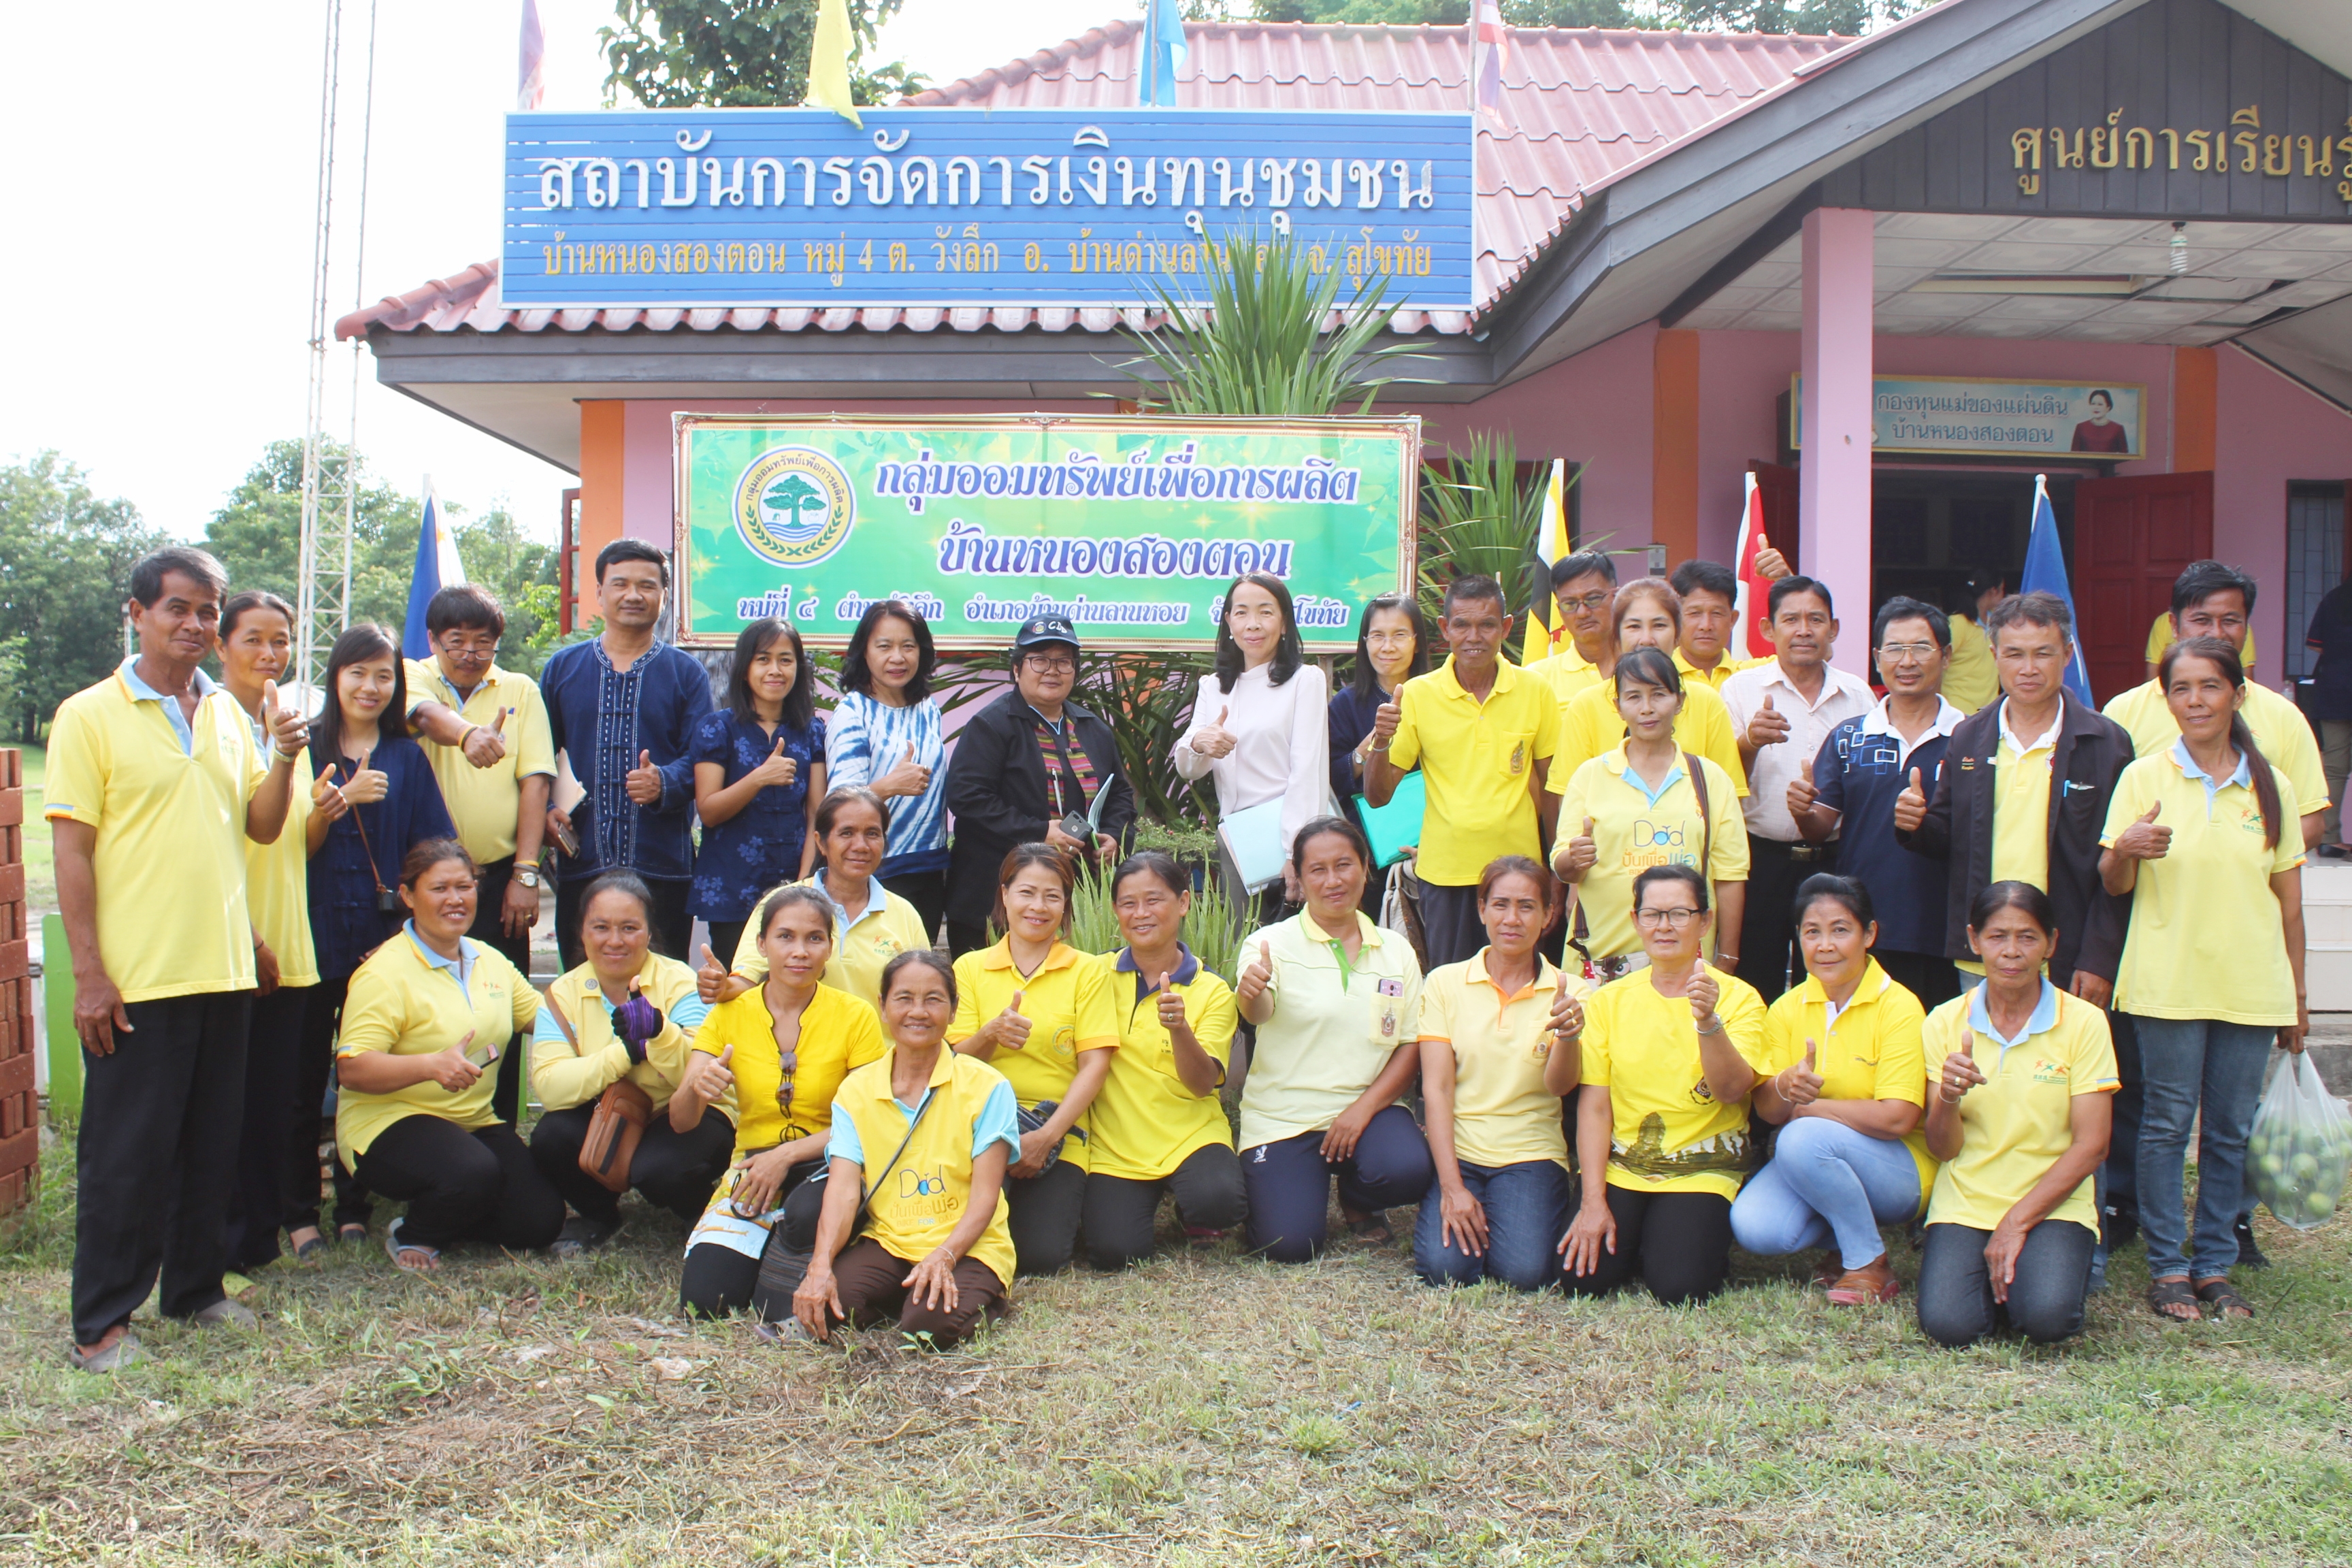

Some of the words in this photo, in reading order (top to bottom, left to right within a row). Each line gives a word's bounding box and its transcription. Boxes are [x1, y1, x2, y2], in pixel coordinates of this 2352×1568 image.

[538, 125, 1433, 234] สถาบันการจัดการเงินทุนชุมชน
[544, 229, 785, 275] บ้านหนองสองตอน
[804, 231, 846, 287] หมู่
[857, 239, 873, 272] 4
[888, 243, 915, 272] ต.
[930, 223, 999, 272] วังลึก
[1024, 243, 1049, 272] อ.
[1347, 227, 1431, 291] สุโขทัย
[1877, 391, 2068, 420] กองทุนแม่ของแผ่นดิน
[1891, 416, 2055, 444] บ้านหนองสองตอน
[877, 444, 1358, 512] กลุ่มออมทรัพย์เพื่อการผลิต
[940, 521, 1292, 576] บ้านหนองสองตอน
[798, 598, 817, 618] ๔
[918, 1217, 934, 1225] FOR
